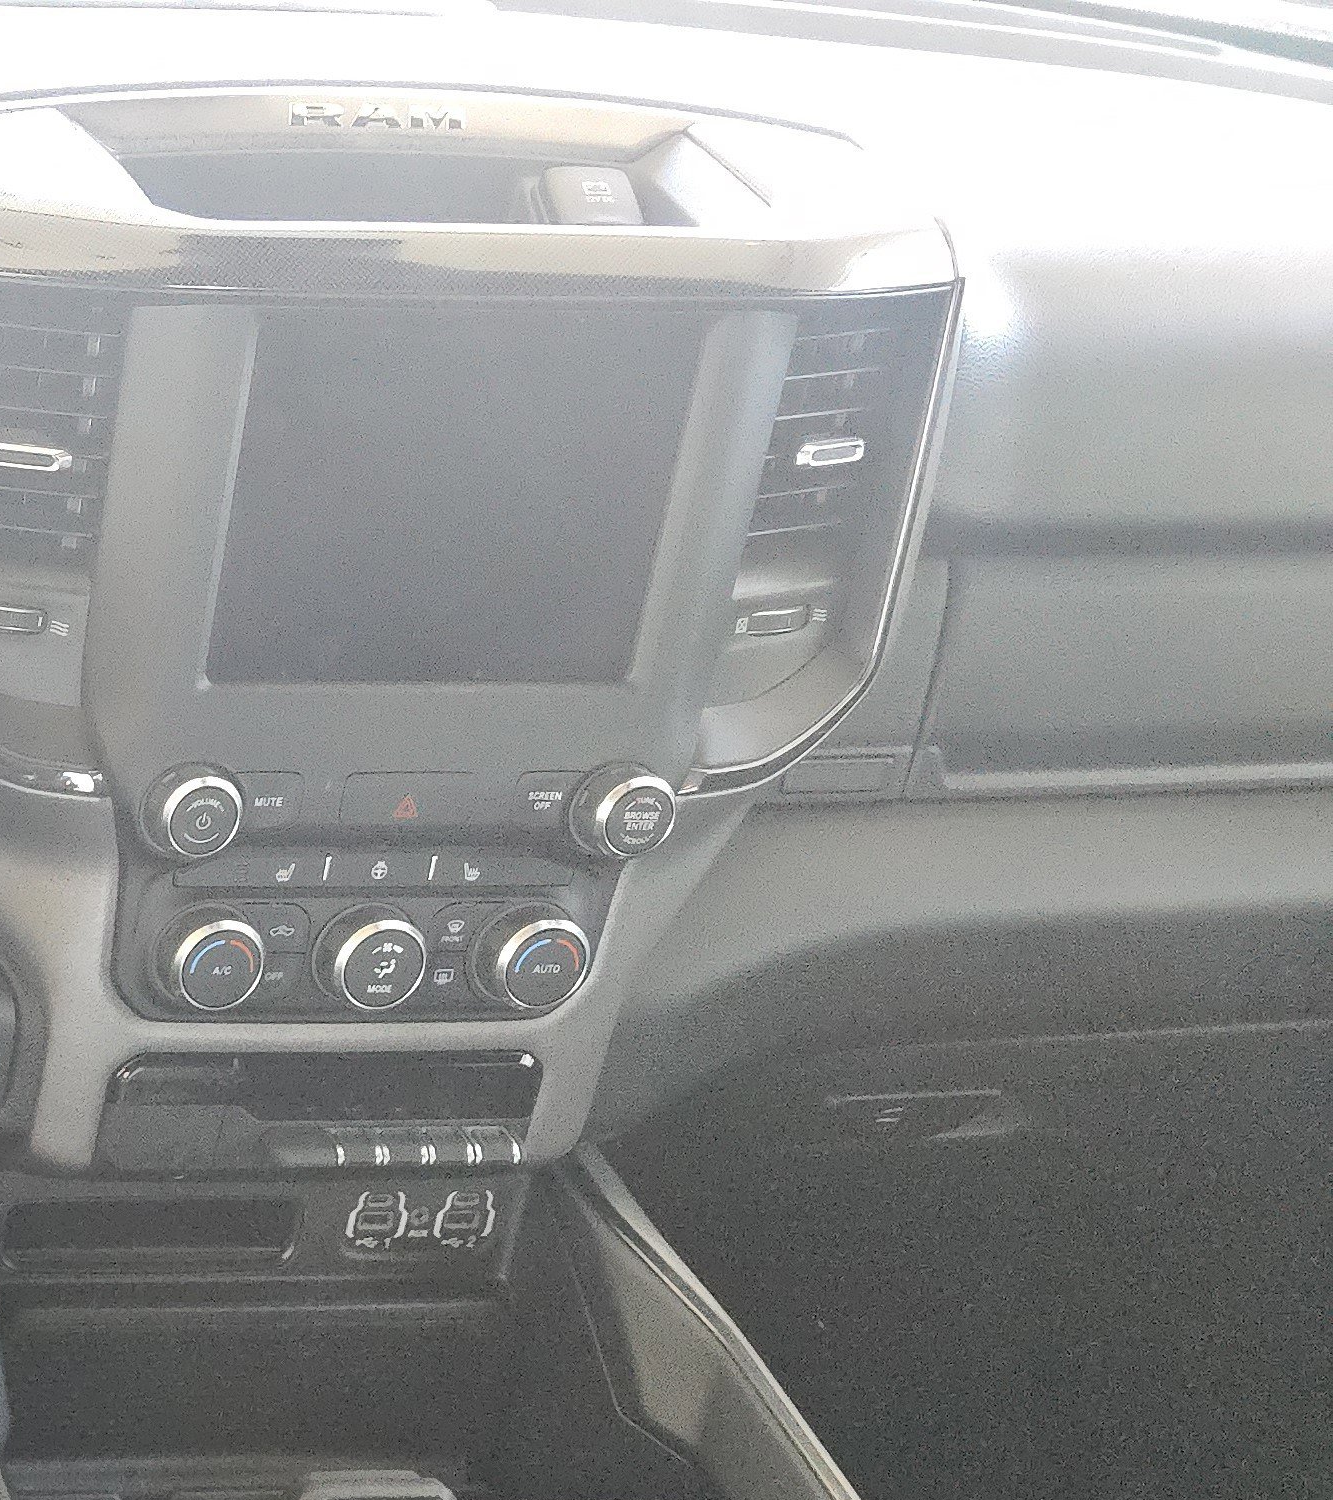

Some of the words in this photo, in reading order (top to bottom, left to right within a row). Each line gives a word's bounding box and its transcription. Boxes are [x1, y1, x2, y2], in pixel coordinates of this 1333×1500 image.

[288, 101, 466, 131] RAM
[527, 791, 563, 801] SCREEN
[254, 796, 284, 807] MUTE
[533, 801, 552, 811] OFF
[623, 811, 661, 821] BROWSE
[625, 821, 655, 831] ENTER
[211, 965, 232, 976] A/C
[532, 964, 561, 974] AUTO
[367, 984, 392, 994] MODE
